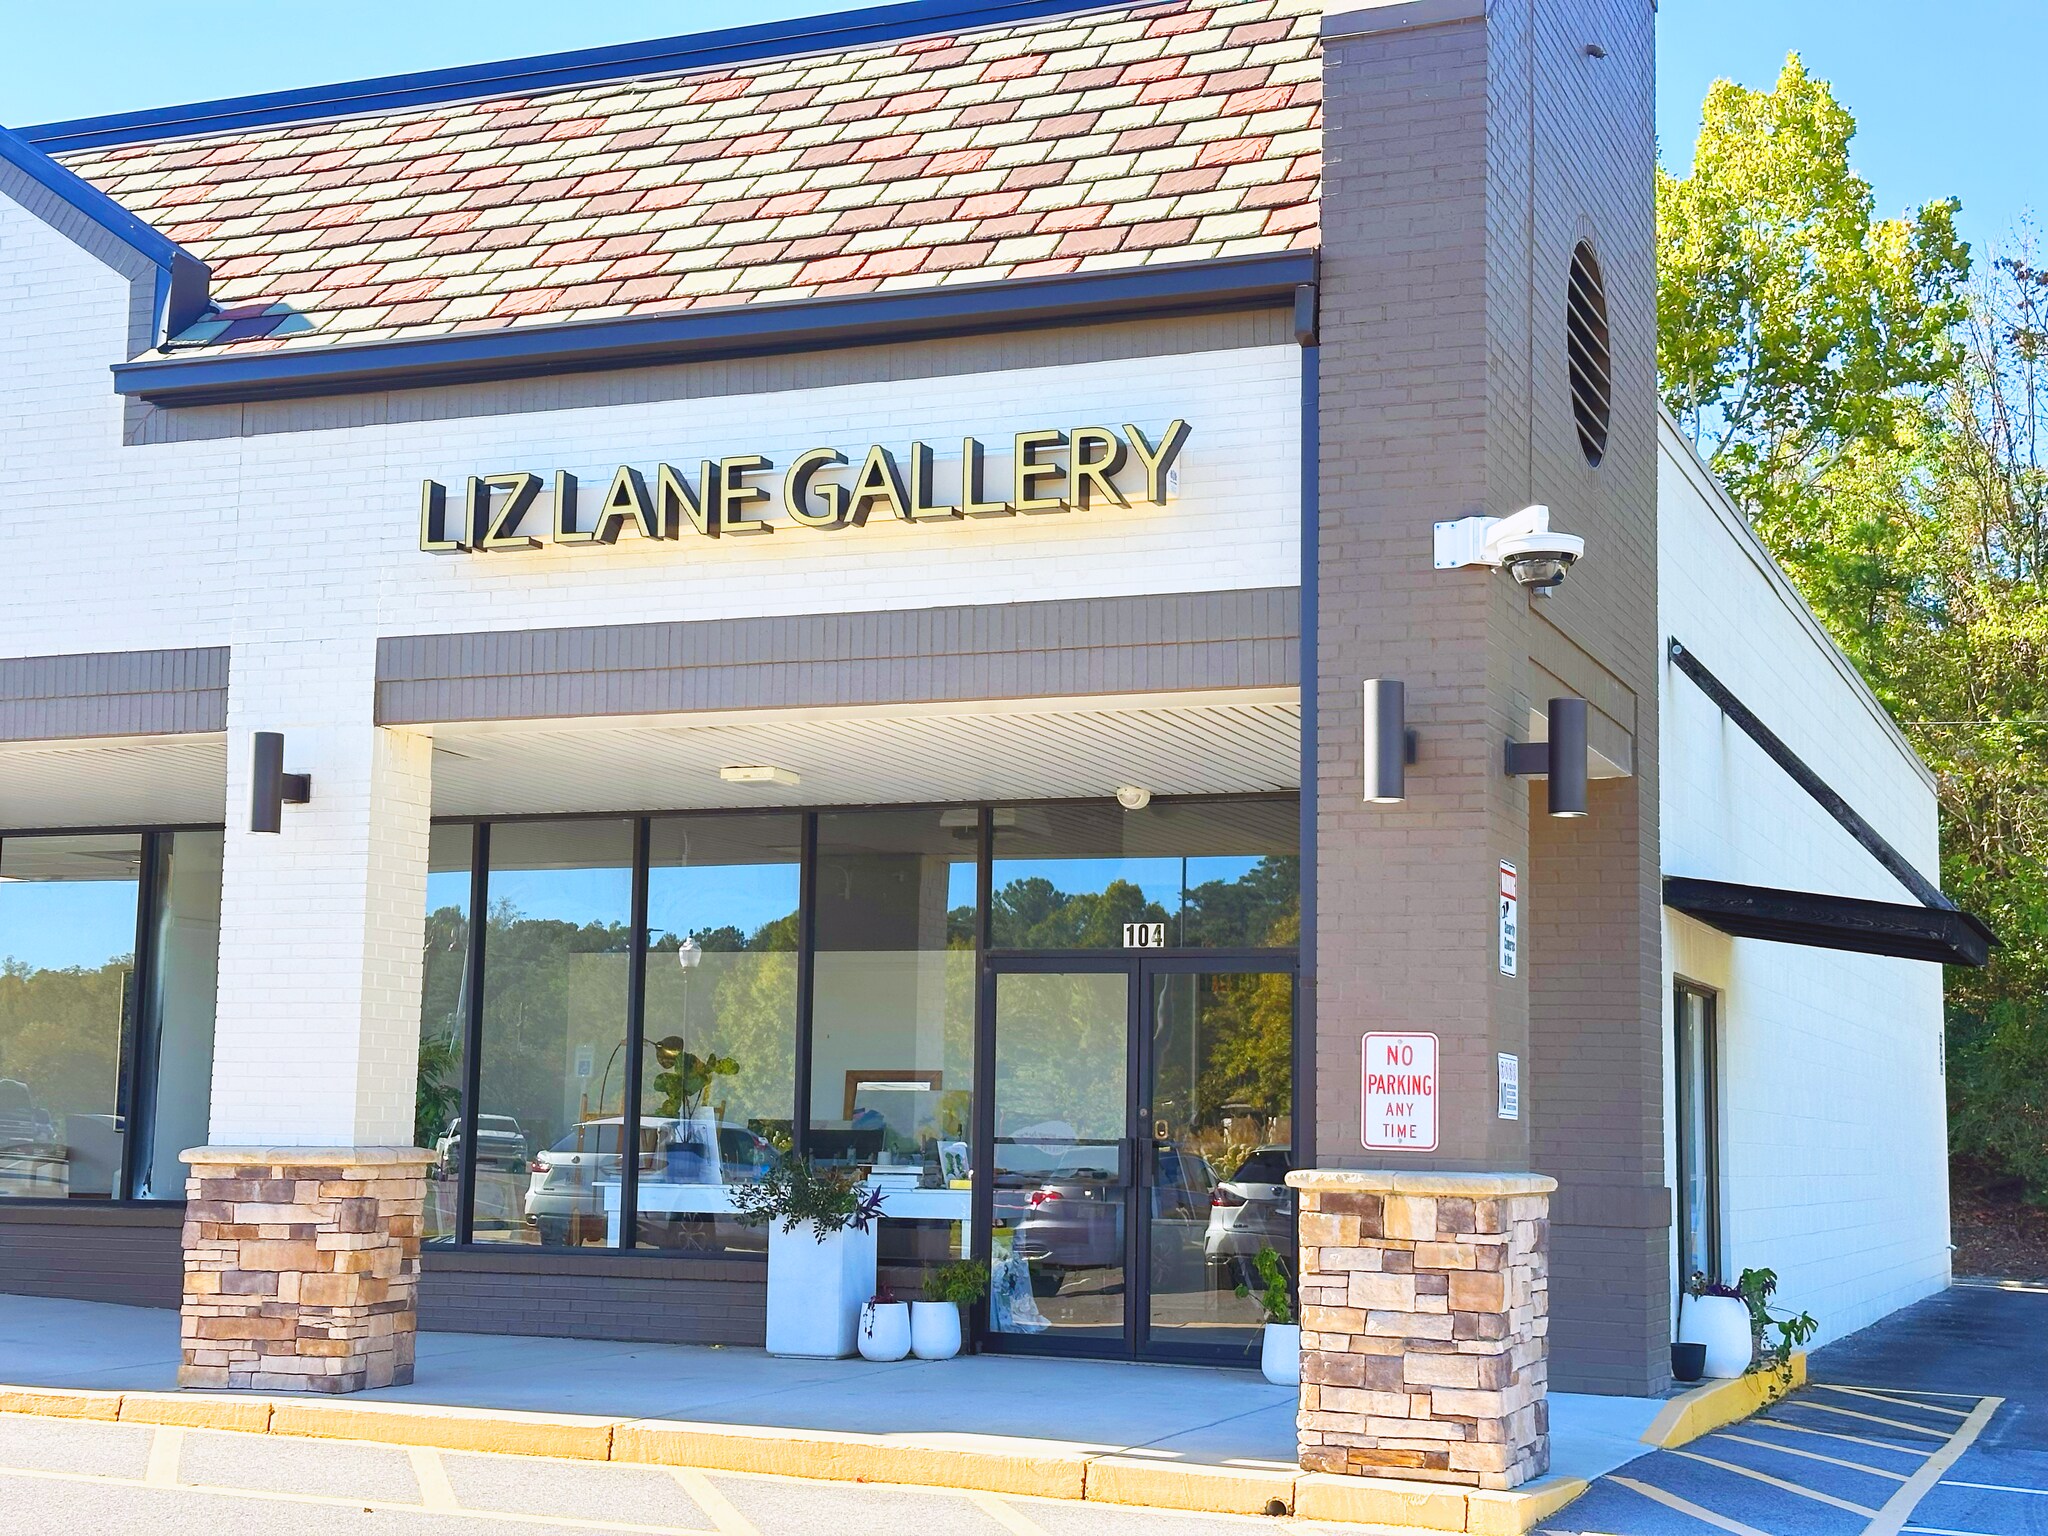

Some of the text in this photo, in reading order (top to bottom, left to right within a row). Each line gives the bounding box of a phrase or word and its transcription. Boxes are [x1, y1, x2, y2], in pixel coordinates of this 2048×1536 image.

[421, 419, 1190, 553] LIZ LANE GALLERY
[1126, 924, 1163, 947] 104
[1387, 1045, 1413, 1066] NO
[1368, 1074, 1432, 1096] PARKING
[1386, 1102, 1414, 1117] ANY
[1383, 1123, 1417, 1139] TIME
